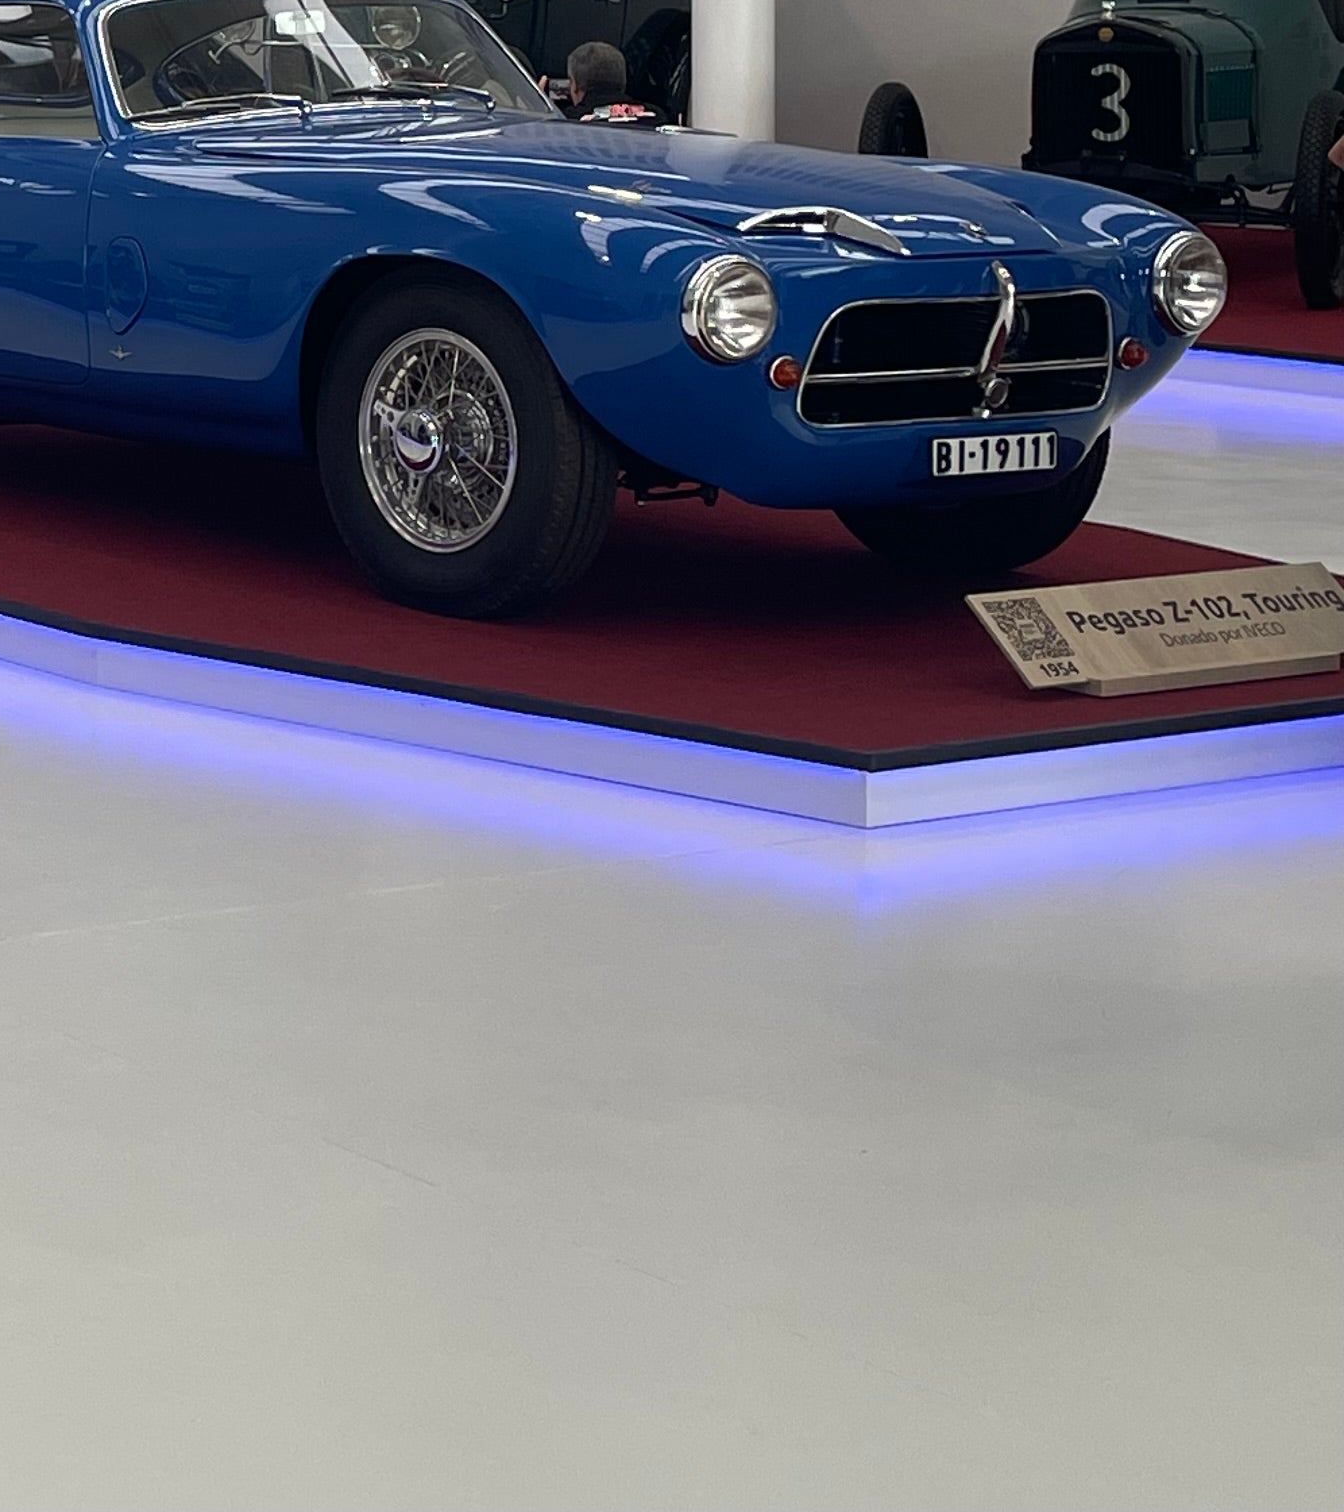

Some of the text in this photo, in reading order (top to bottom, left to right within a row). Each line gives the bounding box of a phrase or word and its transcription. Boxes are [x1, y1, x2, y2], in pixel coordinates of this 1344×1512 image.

[1090, 63, 1132, 142] 3
[936, 434, 1056, 474] BI-19111
[1065, 586, 1344, 635] Pegaso Z-102, Touring
[1159, 622, 1286, 648] Donado por IVECO
[1039, 660, 1080, 678] 1954
